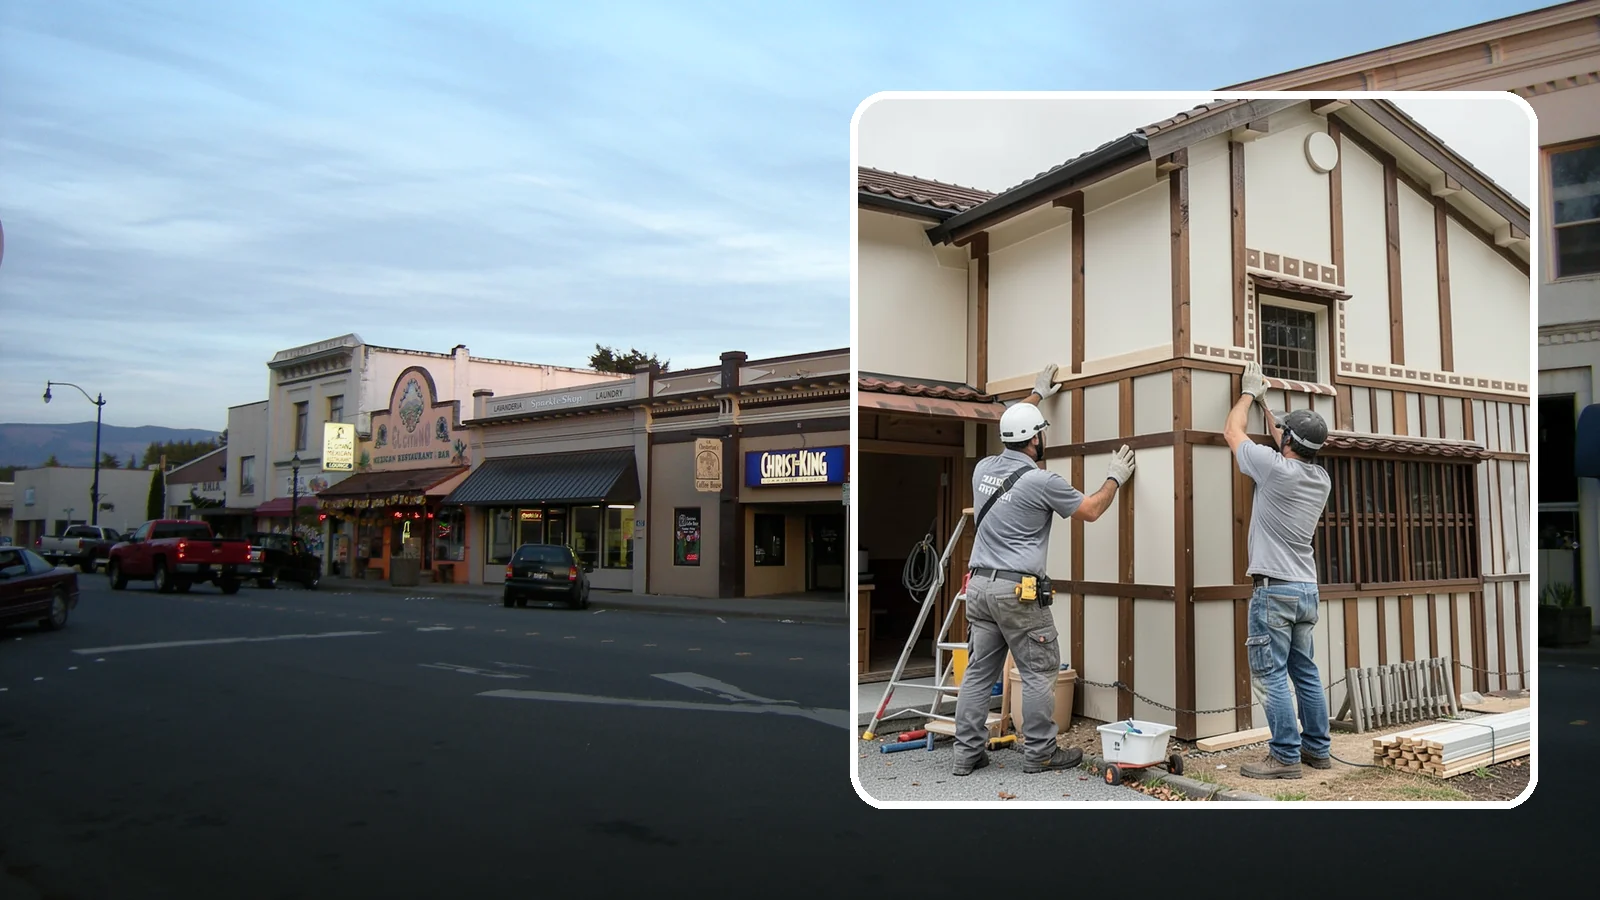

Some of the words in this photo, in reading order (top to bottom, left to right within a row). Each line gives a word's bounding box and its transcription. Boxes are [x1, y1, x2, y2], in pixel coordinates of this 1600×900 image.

[493, 402, 522, 413] LAVANDERIA
[530, 396, 560, 409] Sparkle
[561, 394, 582, 404] Shop
[595, 388, 624, 400] LAUNDRY
[391, 425, 402, 449] EL
[373, 454, 396, 464] MEXICAN
[397, 451, 433, 462] RESTAURANT
[437, 450, 450, 459] BAR
[760, 452, 797, 478] CHRIST
[799, 450, 827, 476] KING
